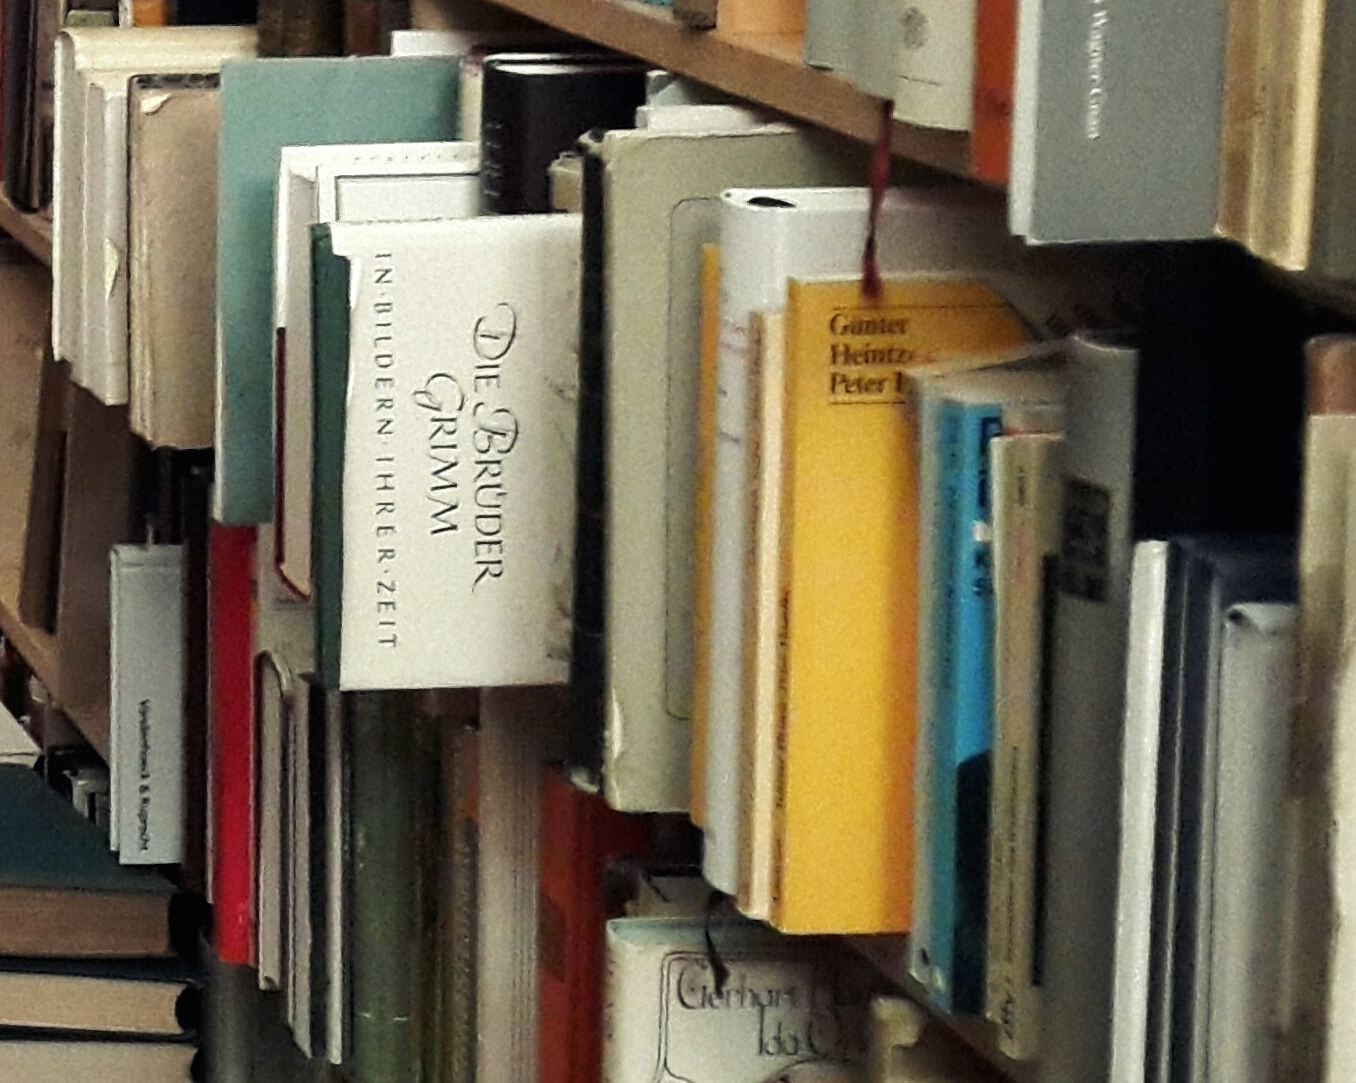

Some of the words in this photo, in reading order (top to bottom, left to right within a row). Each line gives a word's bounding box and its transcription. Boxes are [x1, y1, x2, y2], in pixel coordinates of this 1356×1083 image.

[374, 251, 394, 286] IN
[472, 301, 519, 393] DIE
[829, 310, 910, 336] Günter
[829, 371, 890, 395] Peter
[413, 372, 465, 536] GRIMM
[470, 401, 519, 594] BRÜDER
[375, 580, 398, 650] ZEIT
[138, 698, 151, 780] Vandenhoeck
[139, 783, 151, 795] &
[137, 796, 151, 852] Ruprecht
